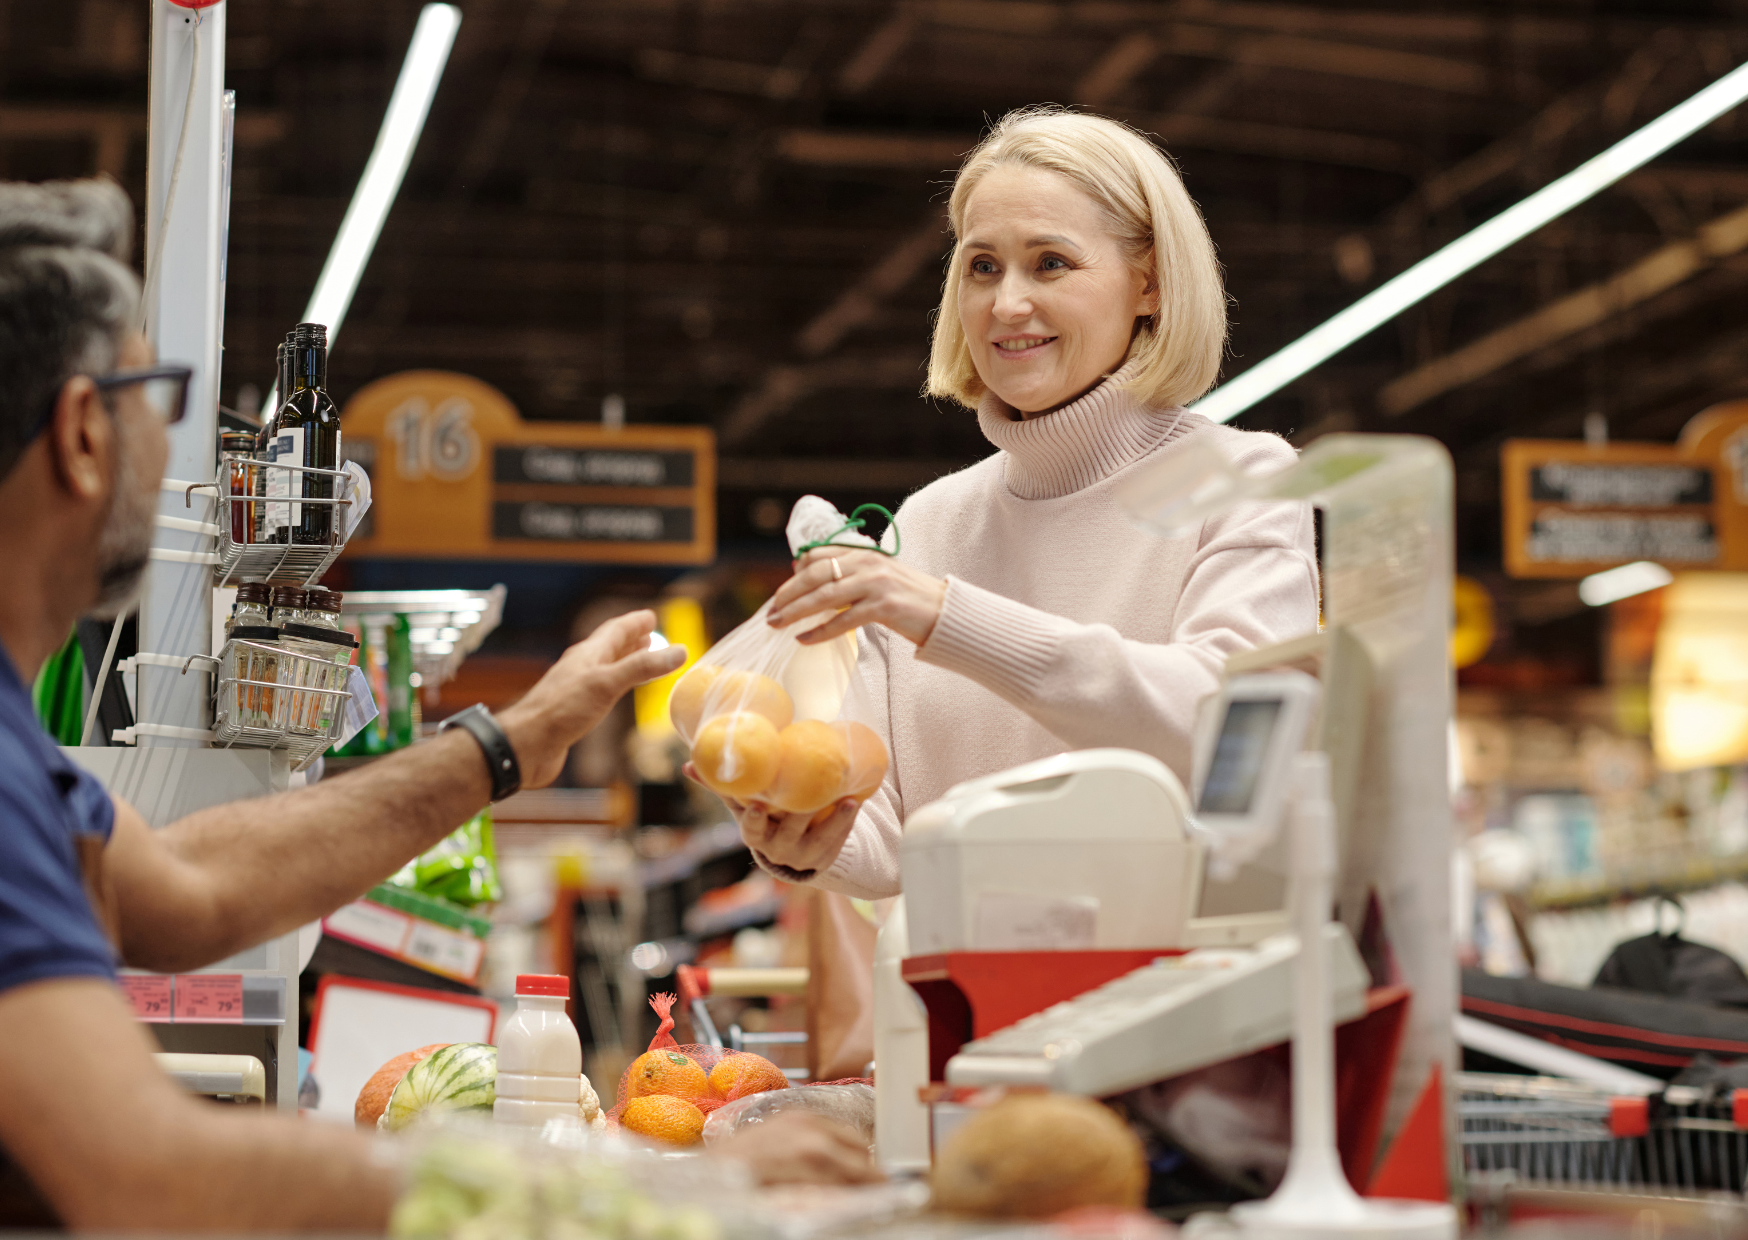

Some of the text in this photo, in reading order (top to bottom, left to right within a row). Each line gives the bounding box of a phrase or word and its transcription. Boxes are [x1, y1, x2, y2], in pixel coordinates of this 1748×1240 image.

[386, 398, 480, 480] 16
[145, 1001, 160, 1012] 79
[218, 1001, 233, 1012] 79
